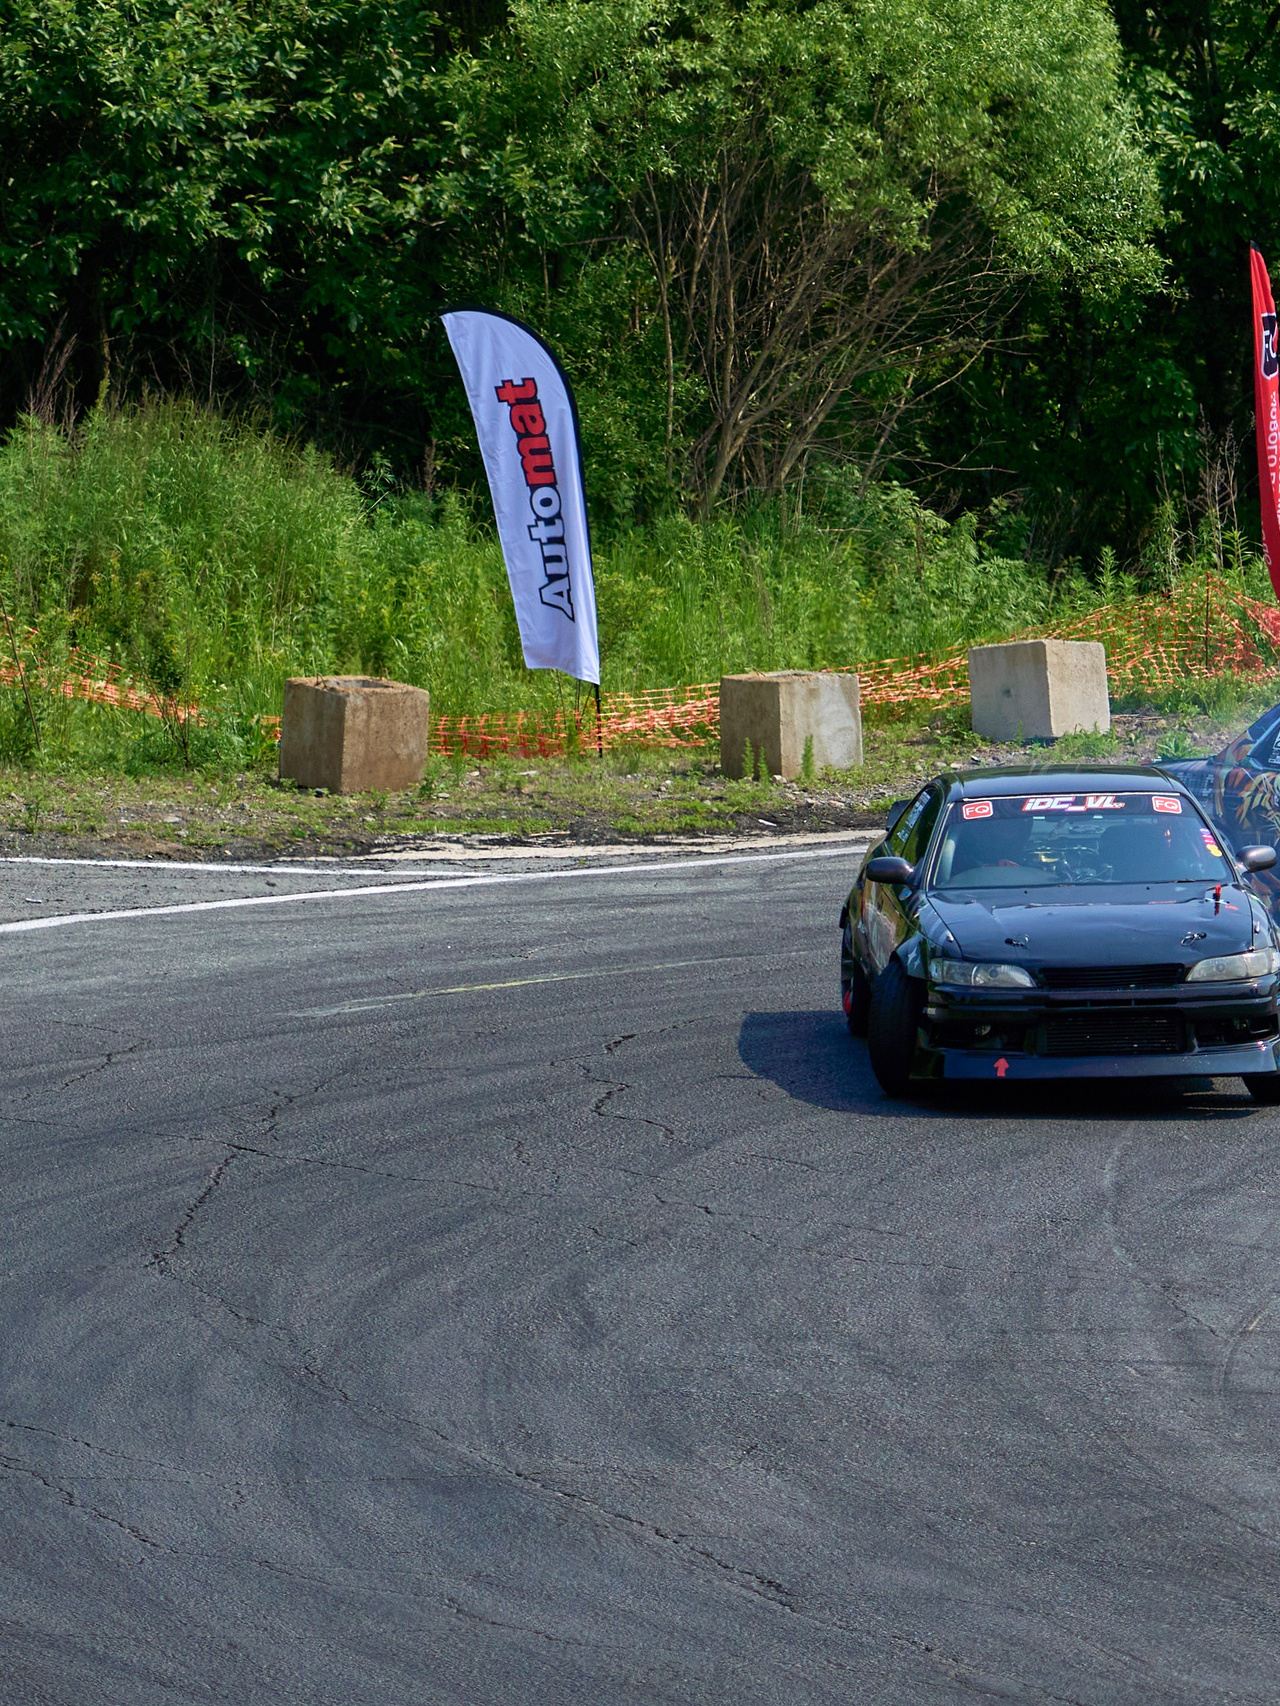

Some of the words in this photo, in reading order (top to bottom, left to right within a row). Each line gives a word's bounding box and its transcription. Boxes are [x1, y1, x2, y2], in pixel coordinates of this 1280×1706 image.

[494, 377, 576, 622] Automat
[965, 804, 990, 815] FQ
[1155, 799, 1179, 811] FQ
